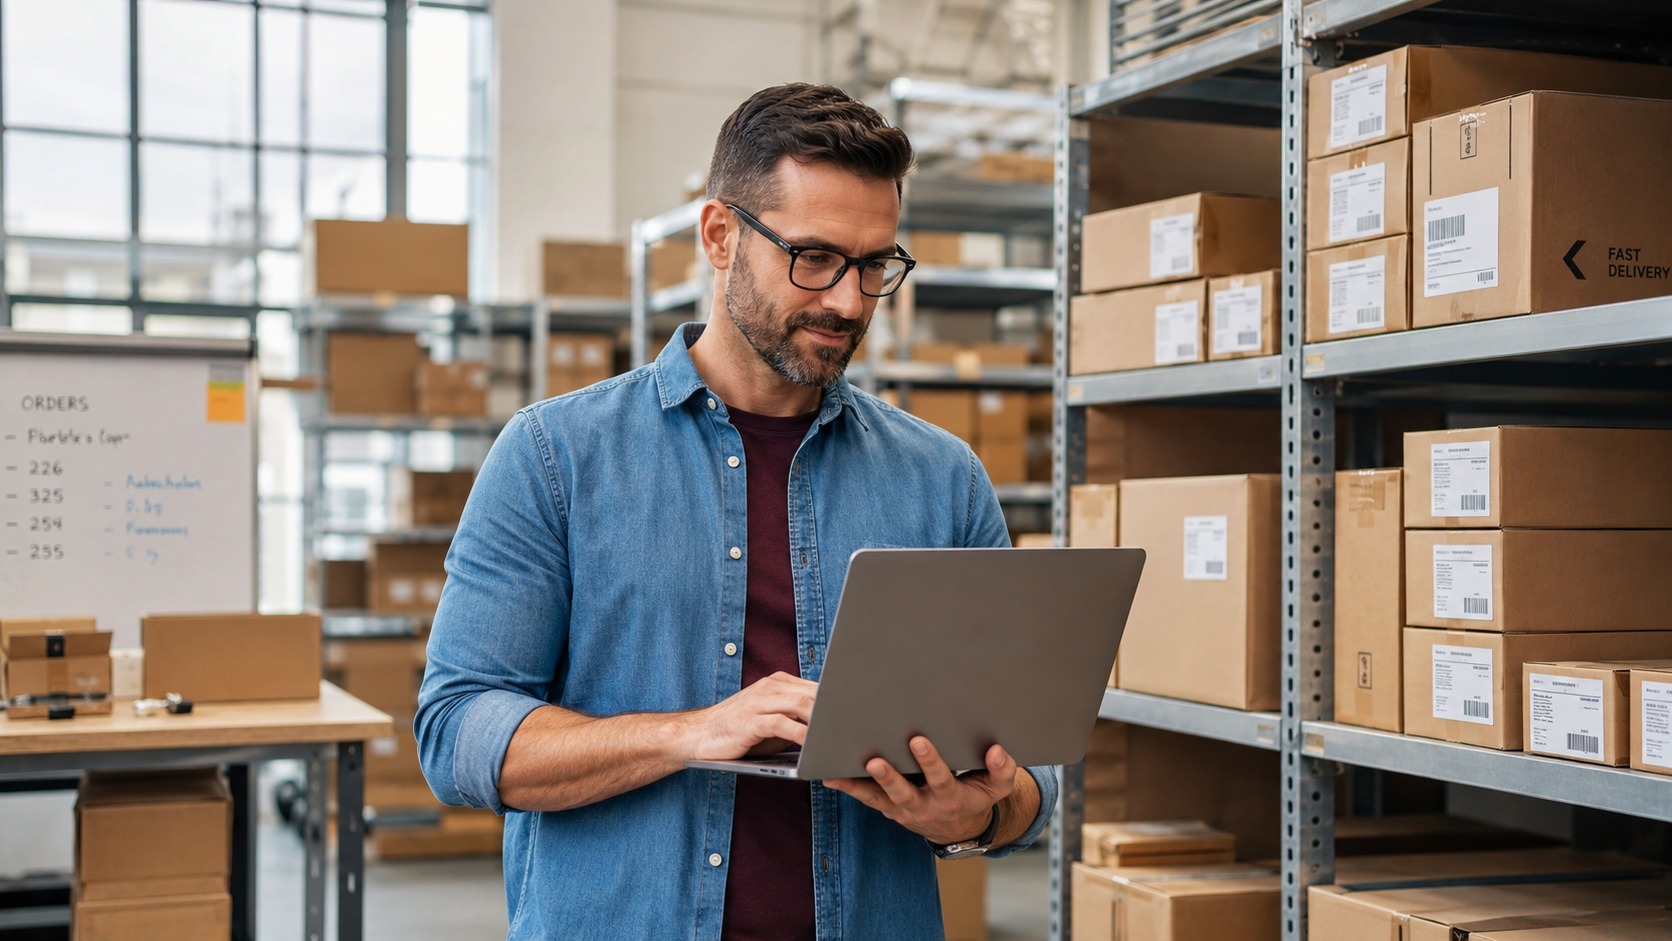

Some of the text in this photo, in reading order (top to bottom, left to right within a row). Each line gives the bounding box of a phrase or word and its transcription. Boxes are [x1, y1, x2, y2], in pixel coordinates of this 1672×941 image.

[1608, 247, 1642, 262] FAST
[1608, 264, 1671, 280] DELIVERY
[21, 395, 89, 412] ORDERS
[29, 460, 63, 475] 226
[29, 488, 63, 504] 325
[29, 516, 62, 532] 254
